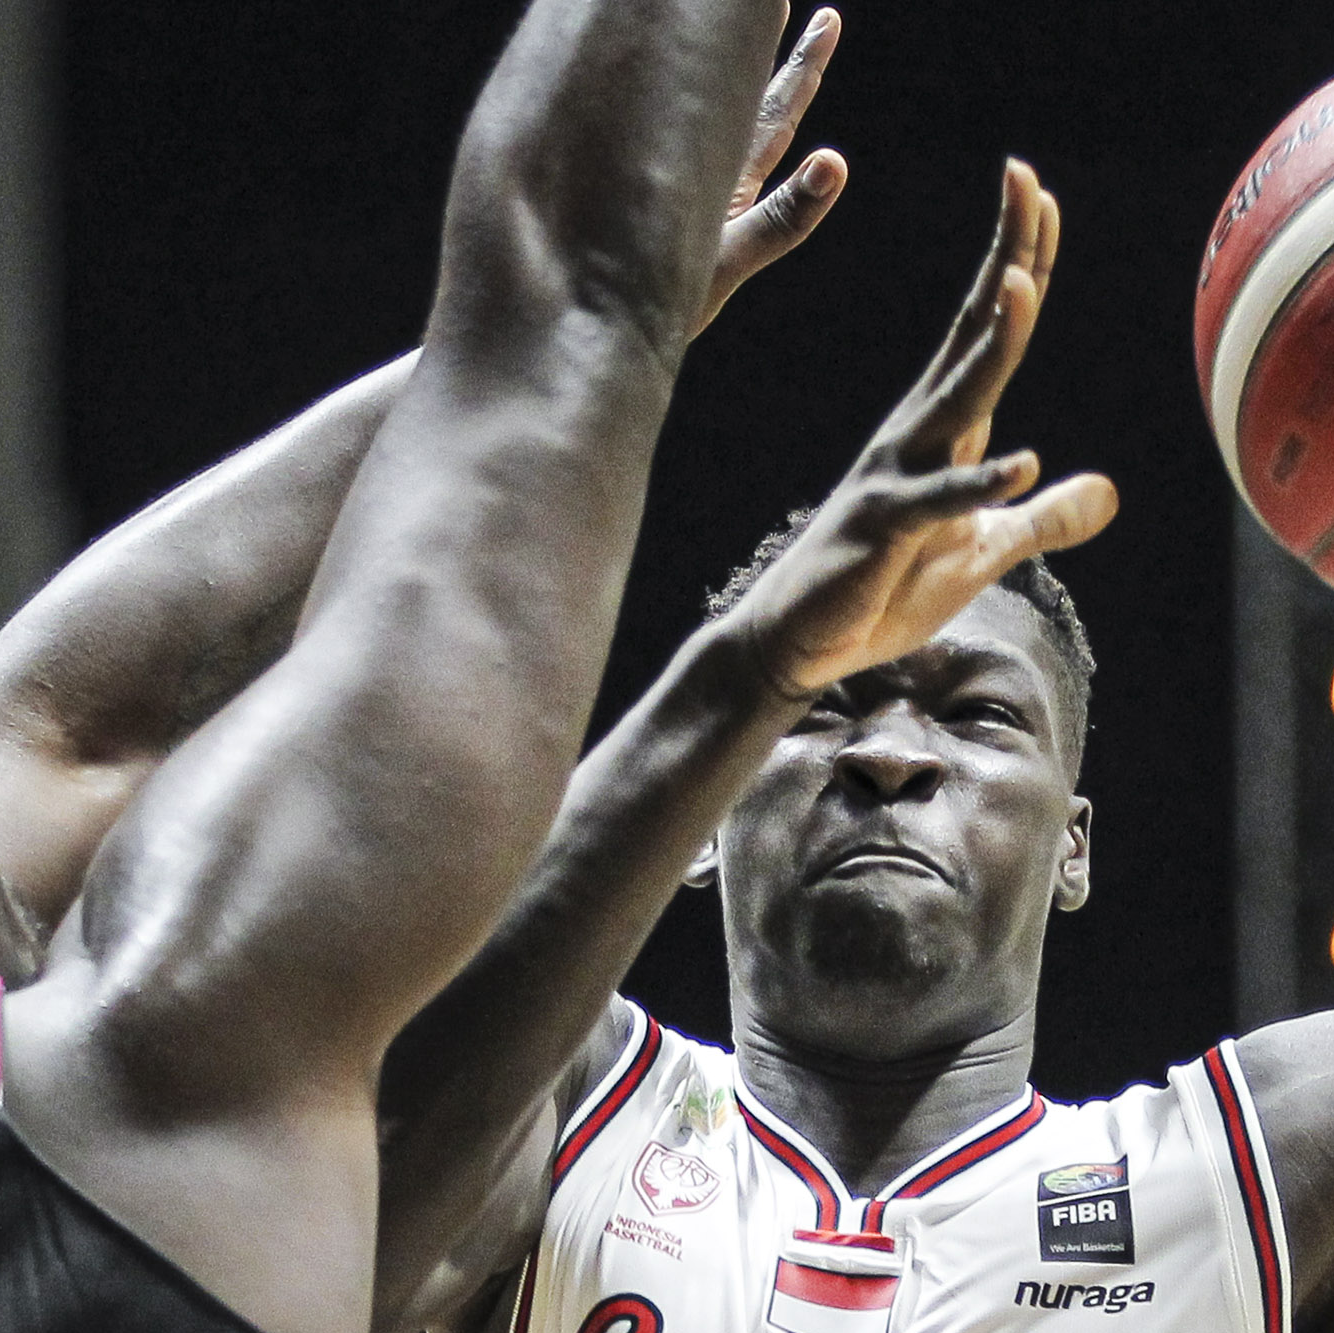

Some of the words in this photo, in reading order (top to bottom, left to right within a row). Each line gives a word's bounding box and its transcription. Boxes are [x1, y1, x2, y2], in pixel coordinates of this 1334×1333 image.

[1052, 1200, 1116, 1227] FIBA
[604, 1220, 683, 1262] BASKETBALL
[616, 1214, 682, 1246] INDONESIA
[1014, 1281, 1156, 1314] nuraga
